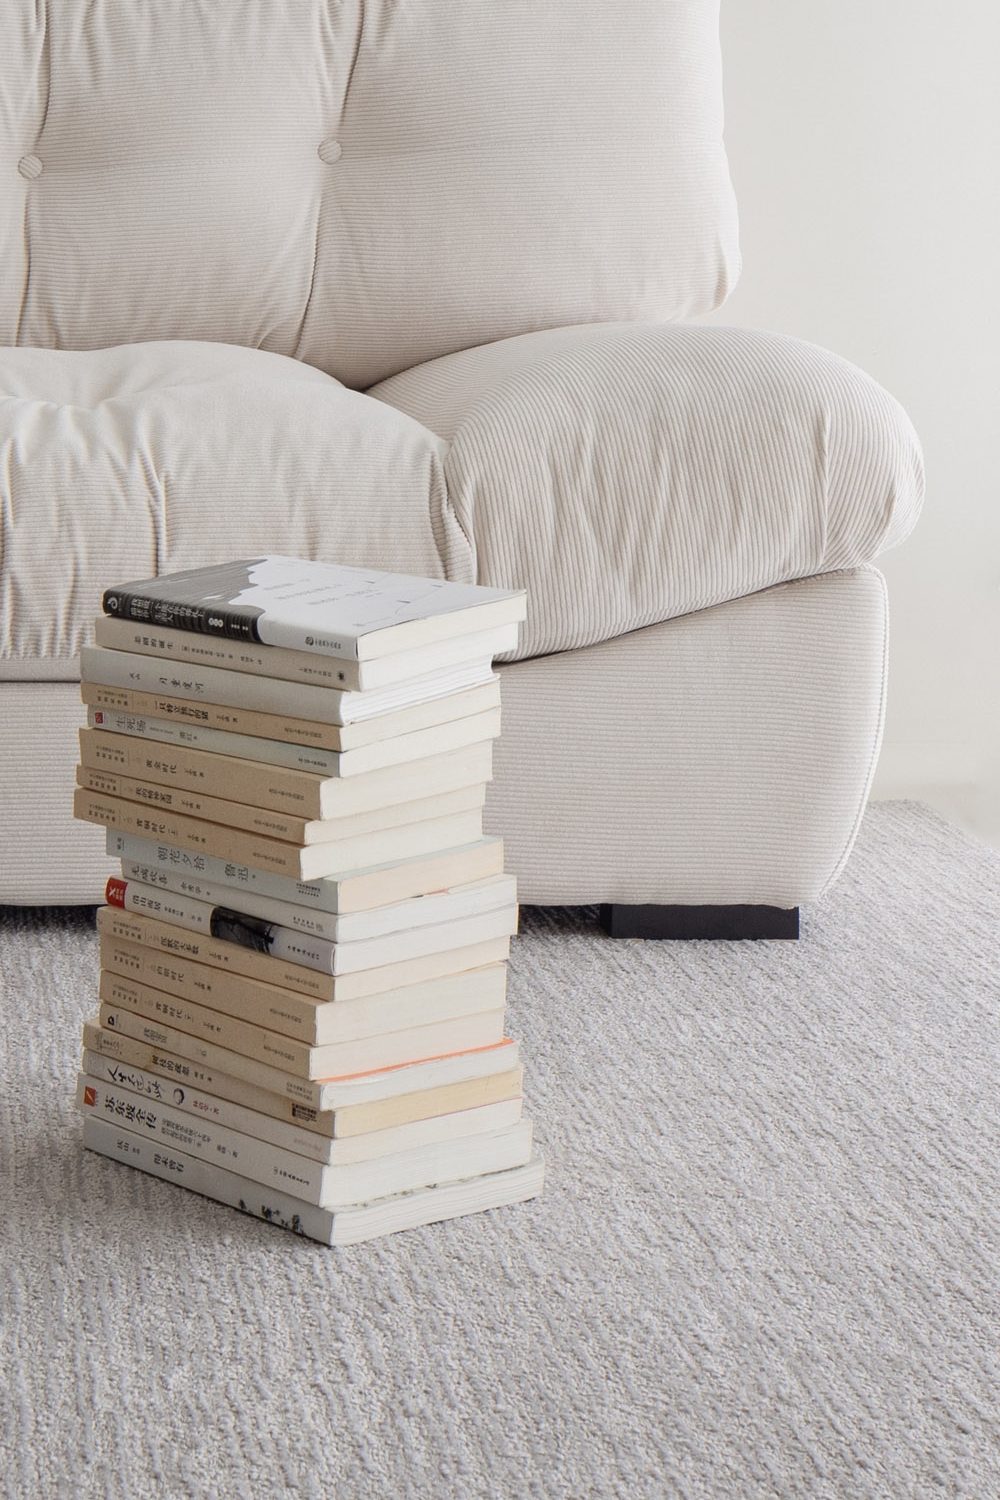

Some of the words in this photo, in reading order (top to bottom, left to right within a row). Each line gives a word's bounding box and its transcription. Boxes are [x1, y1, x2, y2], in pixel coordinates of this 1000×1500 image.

[134, 635, 173, 650] 悲剧的诞生
[159, 677, 204, 694] 月童度河
[154, 700, 209, 721] 一只特立独行的猪
[116, 716, 146, 734] 生死场
[146, 759, 177, 774] 黄金时代
[135, 787, 172, 804] 我的精神家园
[158, 846, 206, 871] 朝花夕拾
[224, 863, 249, 882] 鲁迅
[131, 865, 168, 886] 无端欢喜
[132, 894, 162, 912] 借山而居
[160, 936, 199, 955] 沉默的大多数
[157, 965, 184, 982] 白银时代
[104, 1095, 157, 1129] 苏东坡全传
[153, 1153, 185, 1173] 得未曾有
